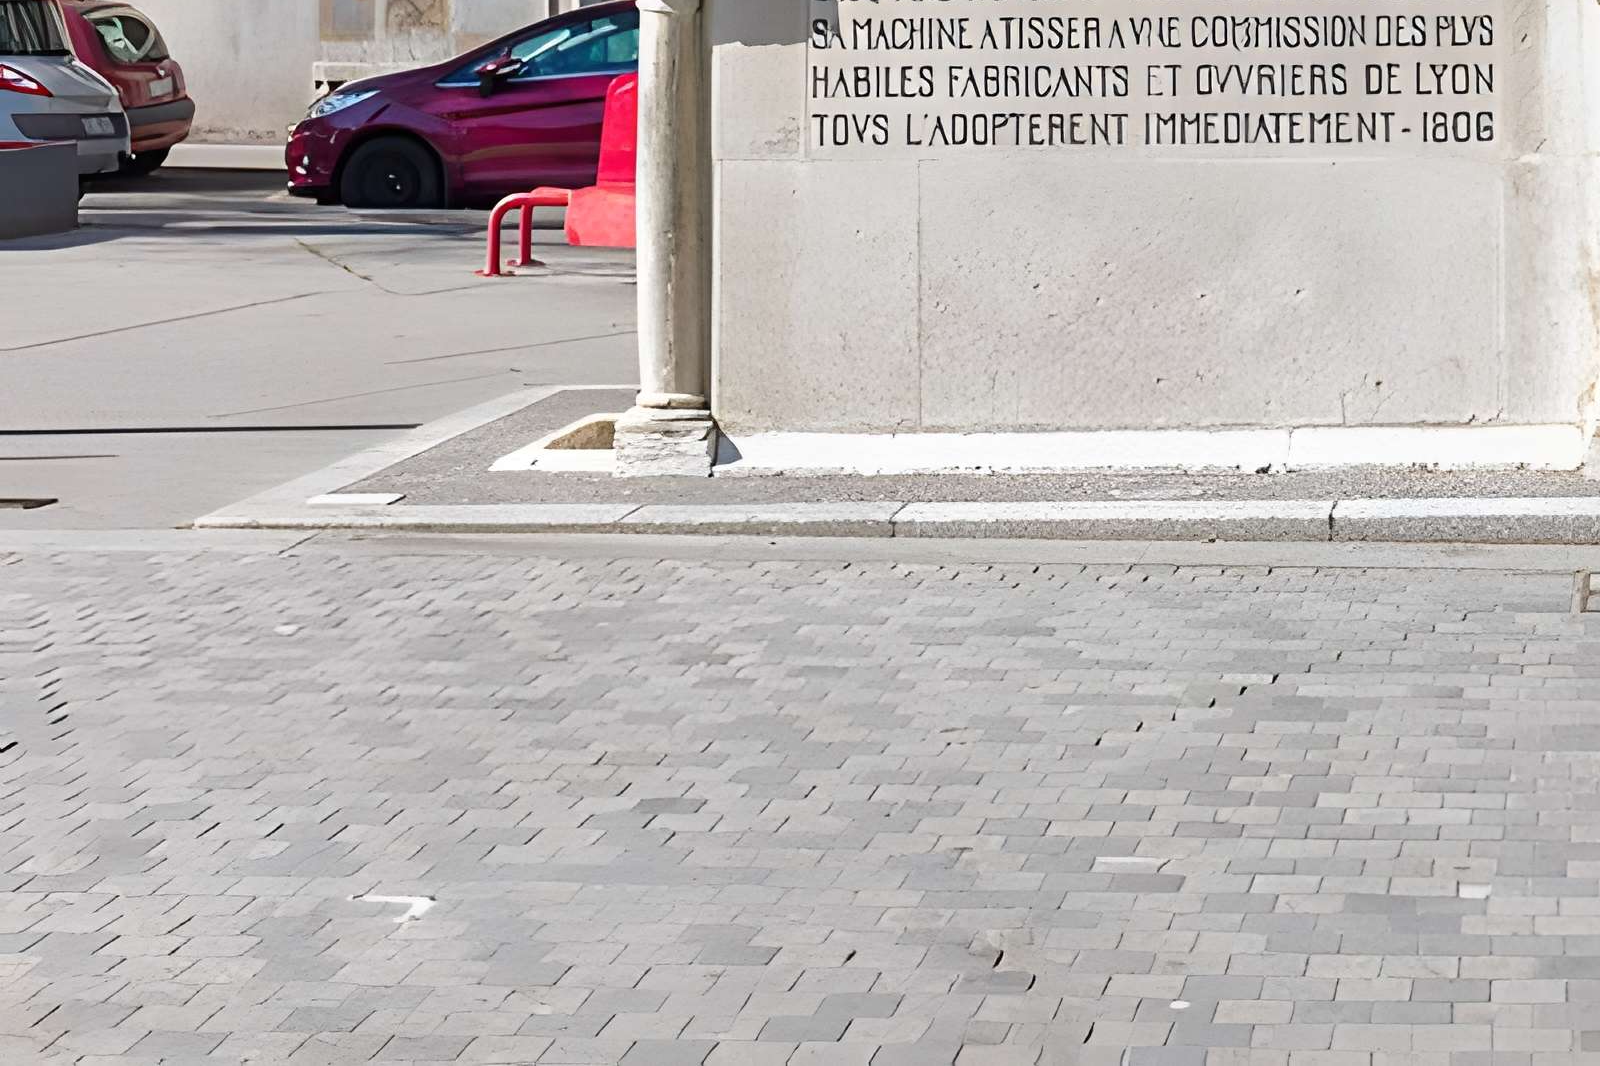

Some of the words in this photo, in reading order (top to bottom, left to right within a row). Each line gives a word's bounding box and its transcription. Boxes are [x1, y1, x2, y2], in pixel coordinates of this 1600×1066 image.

[812, 17, 847, 49] SA
[853, 17, 973, 49] MACHINE
[981, 19, 998, 49] A
[999, 17, 1101, 49] TISSER
[1108, 18, 1126, 48] A
[1191, 15, 1366, 50] COMMISSION
[1376, 15, 1427, 47] DES
[812, 65, 934, 98] HABILES
[948, 65, 1129, 97] FABRICANTS
[1147, 64, 1182, 96] ET
[1365, 63, 1402, 95] DE
[1416, 62, 1494, 95] LYON
[907, 113, 1129, 146] L'ADOPTERENT
[1145, 112, 1396, 145] IMMEDIATEMENT
[1422, 111, 1494, 143] 1806
